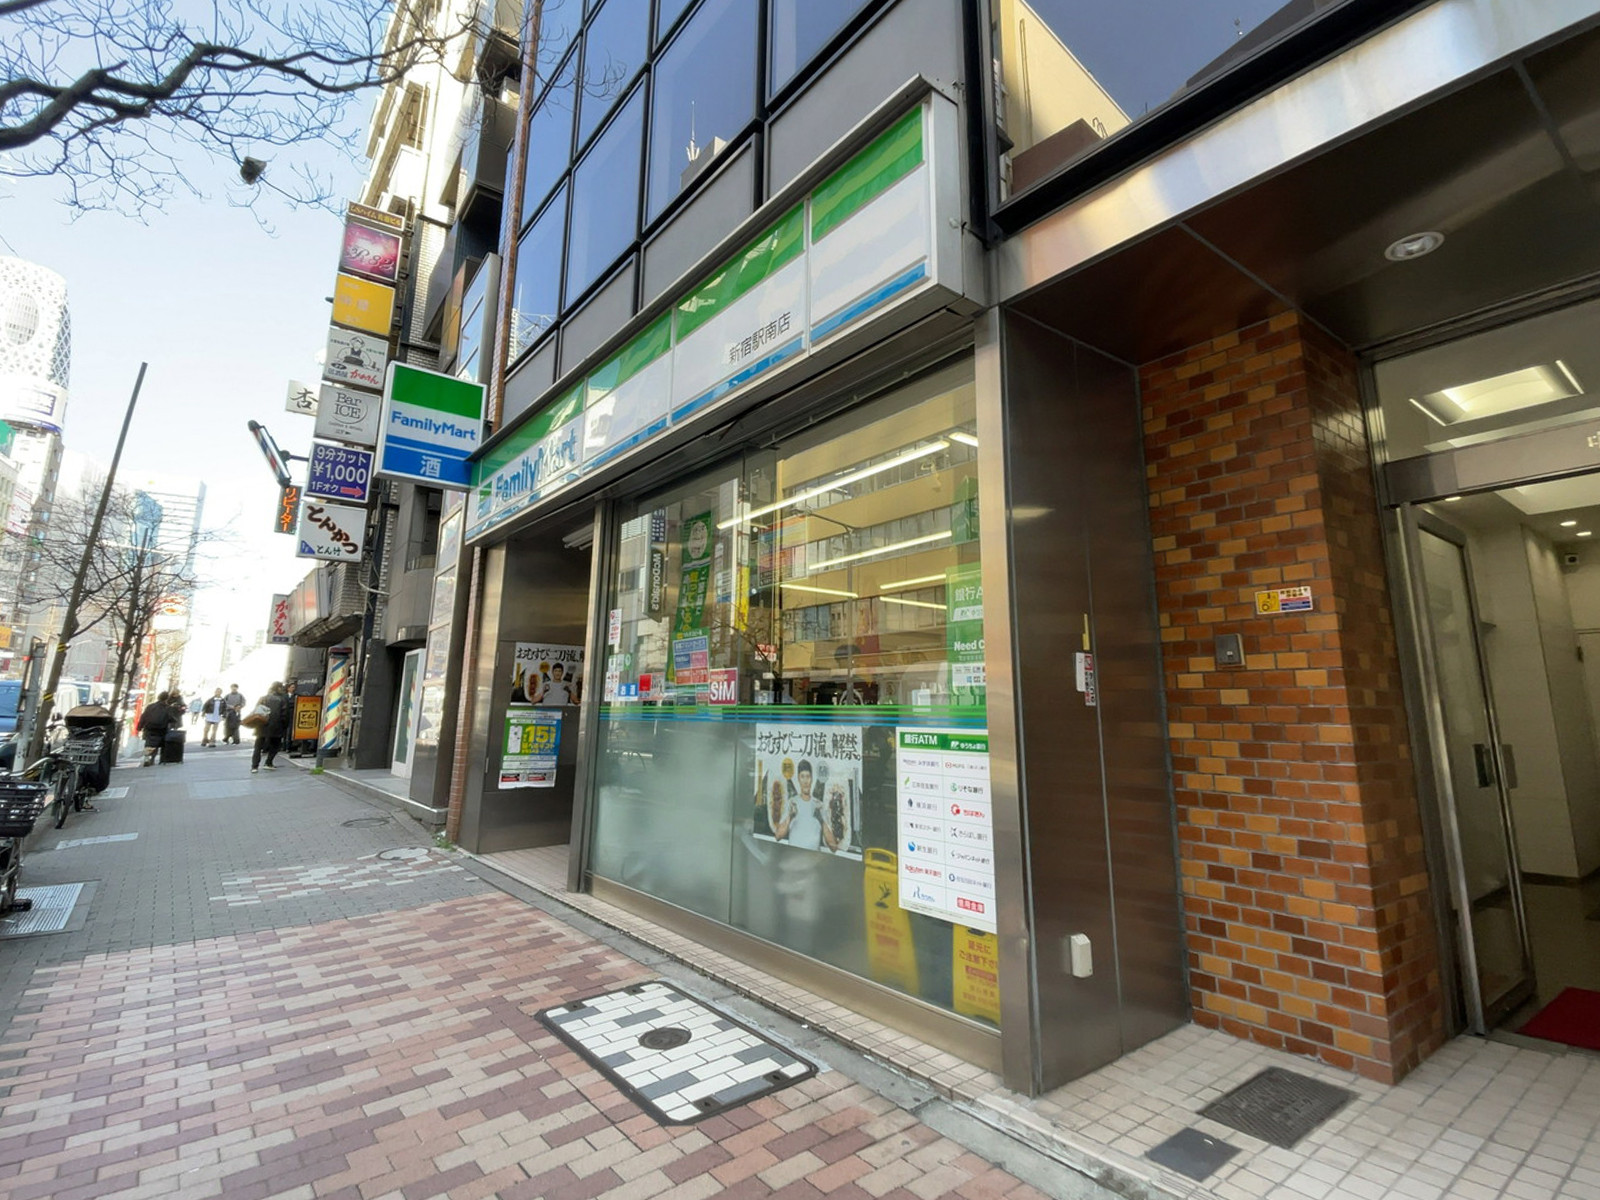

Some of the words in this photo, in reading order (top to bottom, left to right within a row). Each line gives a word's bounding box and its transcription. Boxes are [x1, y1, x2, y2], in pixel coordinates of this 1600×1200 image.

[729, 311, 791, 364] 新宿駅南店
[336, 391, 362, 407] Bar
[334, 403, 361, 420] ICE
[391, 410, 476, 441] FamilyMart
[316, 446, 368, 466] 9分カット
[494, 427, 577, 503] FamilyMart
[313, 460, 367, 484] ¥1,000
[420, 455, 442, 478] 酒
[310, 481, 339, 494] 1Fオク
[307, 505, 360, 555] とんかつ
[954, 640, 978, 652] Need
[710, 681, 735, 701] SIM
[904, 734, 938, 745] 銀行ATM
